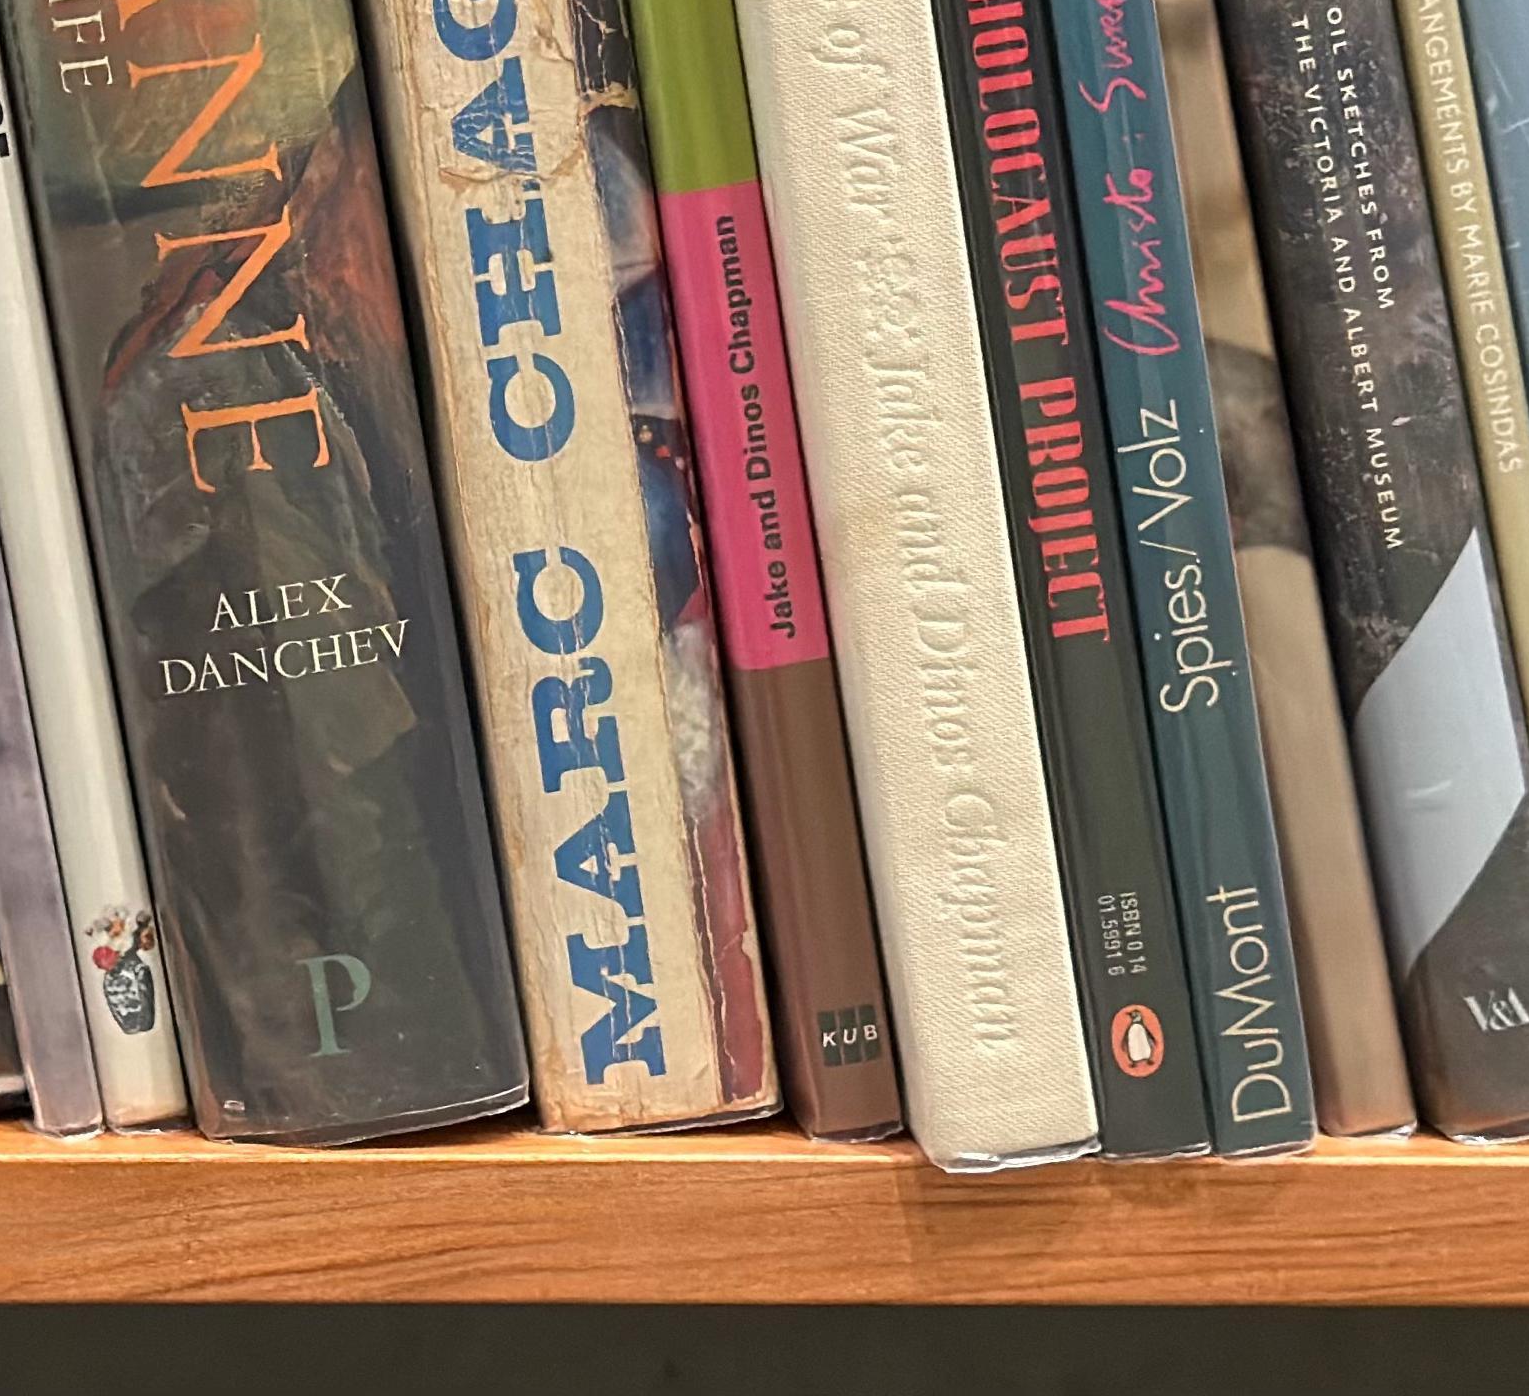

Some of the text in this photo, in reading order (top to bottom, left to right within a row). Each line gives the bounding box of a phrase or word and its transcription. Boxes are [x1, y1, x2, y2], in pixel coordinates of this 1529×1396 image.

[1325, 6, 1396, 310] OIL SKETCHES FROM
[1450, 180, 1477, 213] BY
[1290, 15, 1403, 551] THE VICTORIA AND ALBERT MUSEUM
[1457, 220, 1495, 314] MARIE
[715, 215, 797, 640] Jake and Dinos Chapman
[1474, 323, 1524, 474] COSINDAS
[209, 572, 354, 635] ALEX
[1018, 375, 1111, 643] PROJECT
[158, 618, 412, 696] DANCHEV
[511, 545, 667, 1085] MARC
[296, 952, 372, 1058] P
[1206, 885, 1292, 1123] DuMont
